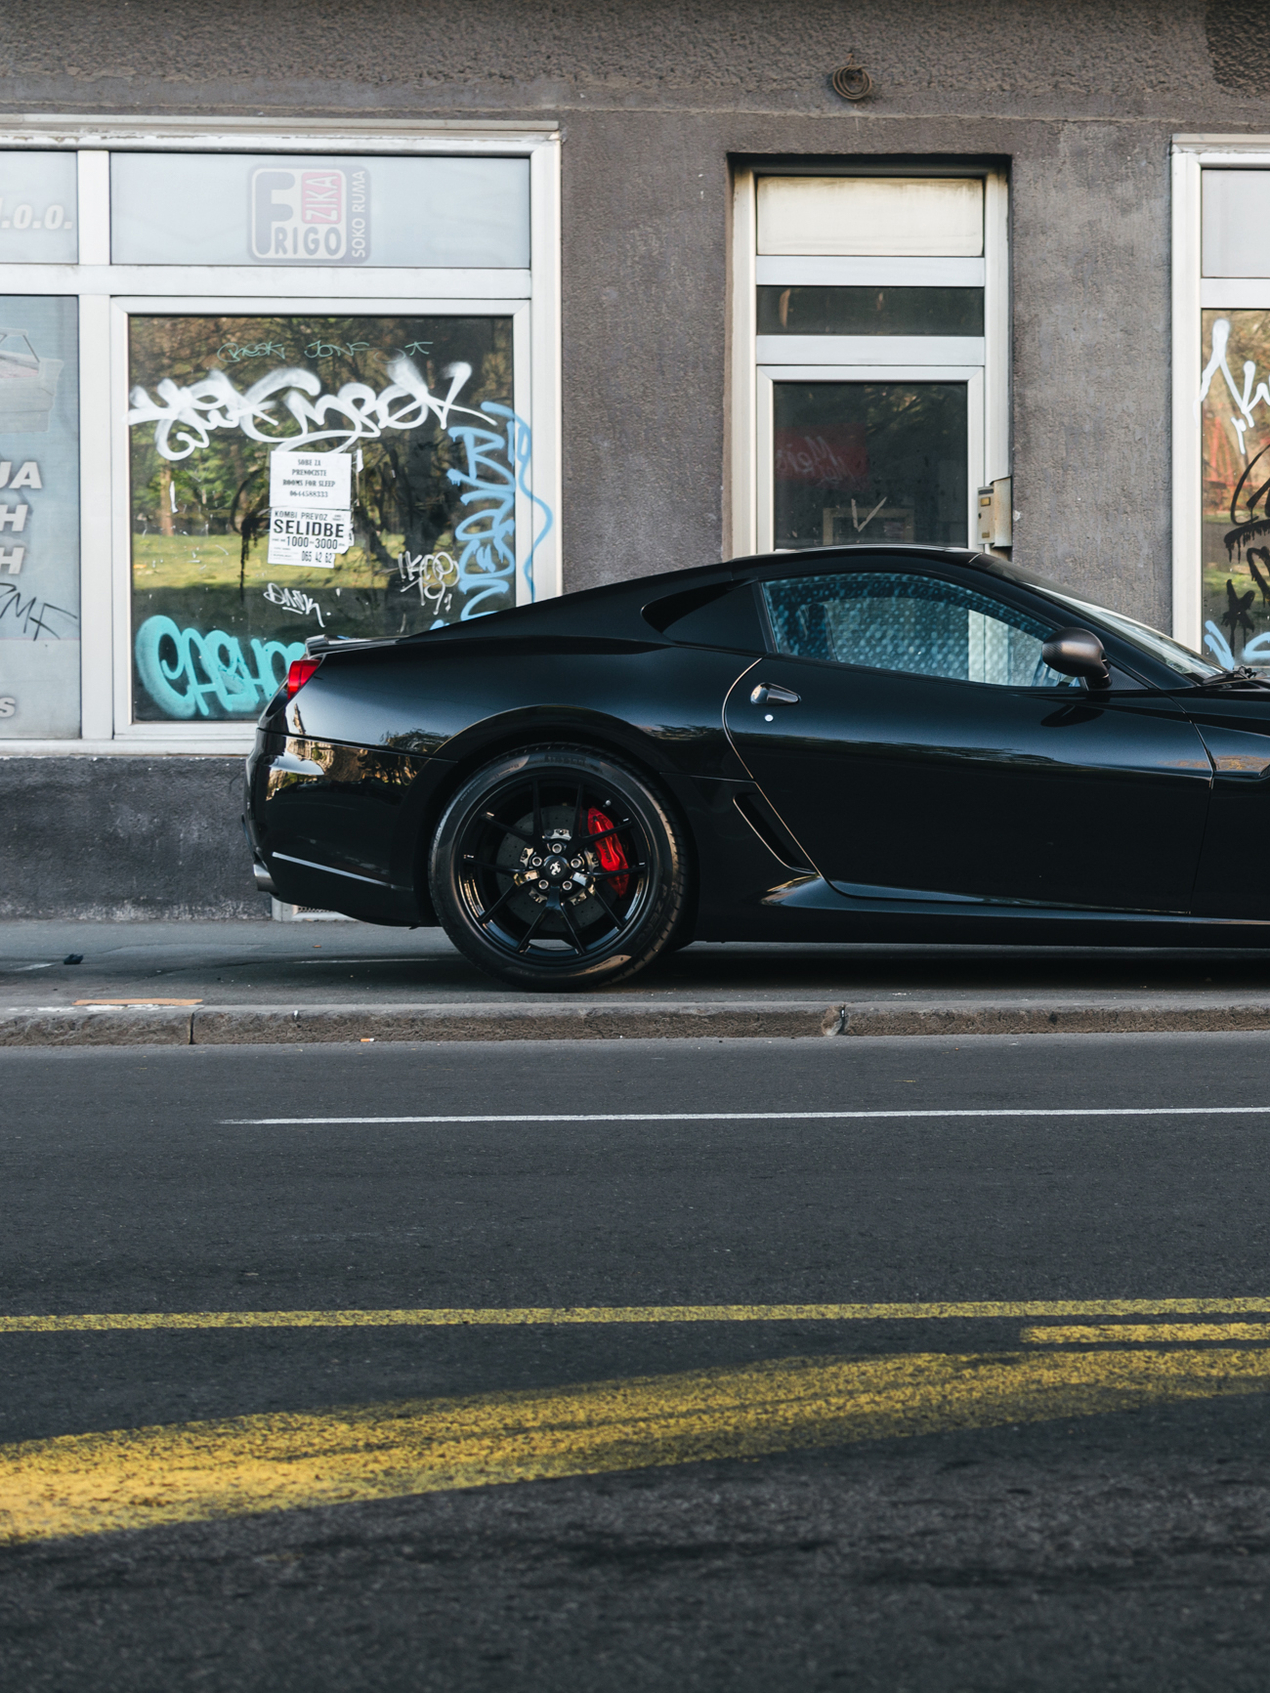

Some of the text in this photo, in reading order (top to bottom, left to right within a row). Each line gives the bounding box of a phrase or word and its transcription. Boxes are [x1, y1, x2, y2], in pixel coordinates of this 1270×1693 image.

[0, 197, 73, 230] .o.o.
[255, 171, 341, 256] FRIGO
[304, 175, 338, 221] ZIKA
[351, 171, 366, 258] SOKO RUMA
[273, 519, 345, 539] SELIDBE
[274, 510, 298, 520] KOMBI
[300, 512, 328, 522] PREVOZ
[286, 535, 339, 550] 1000 3000
